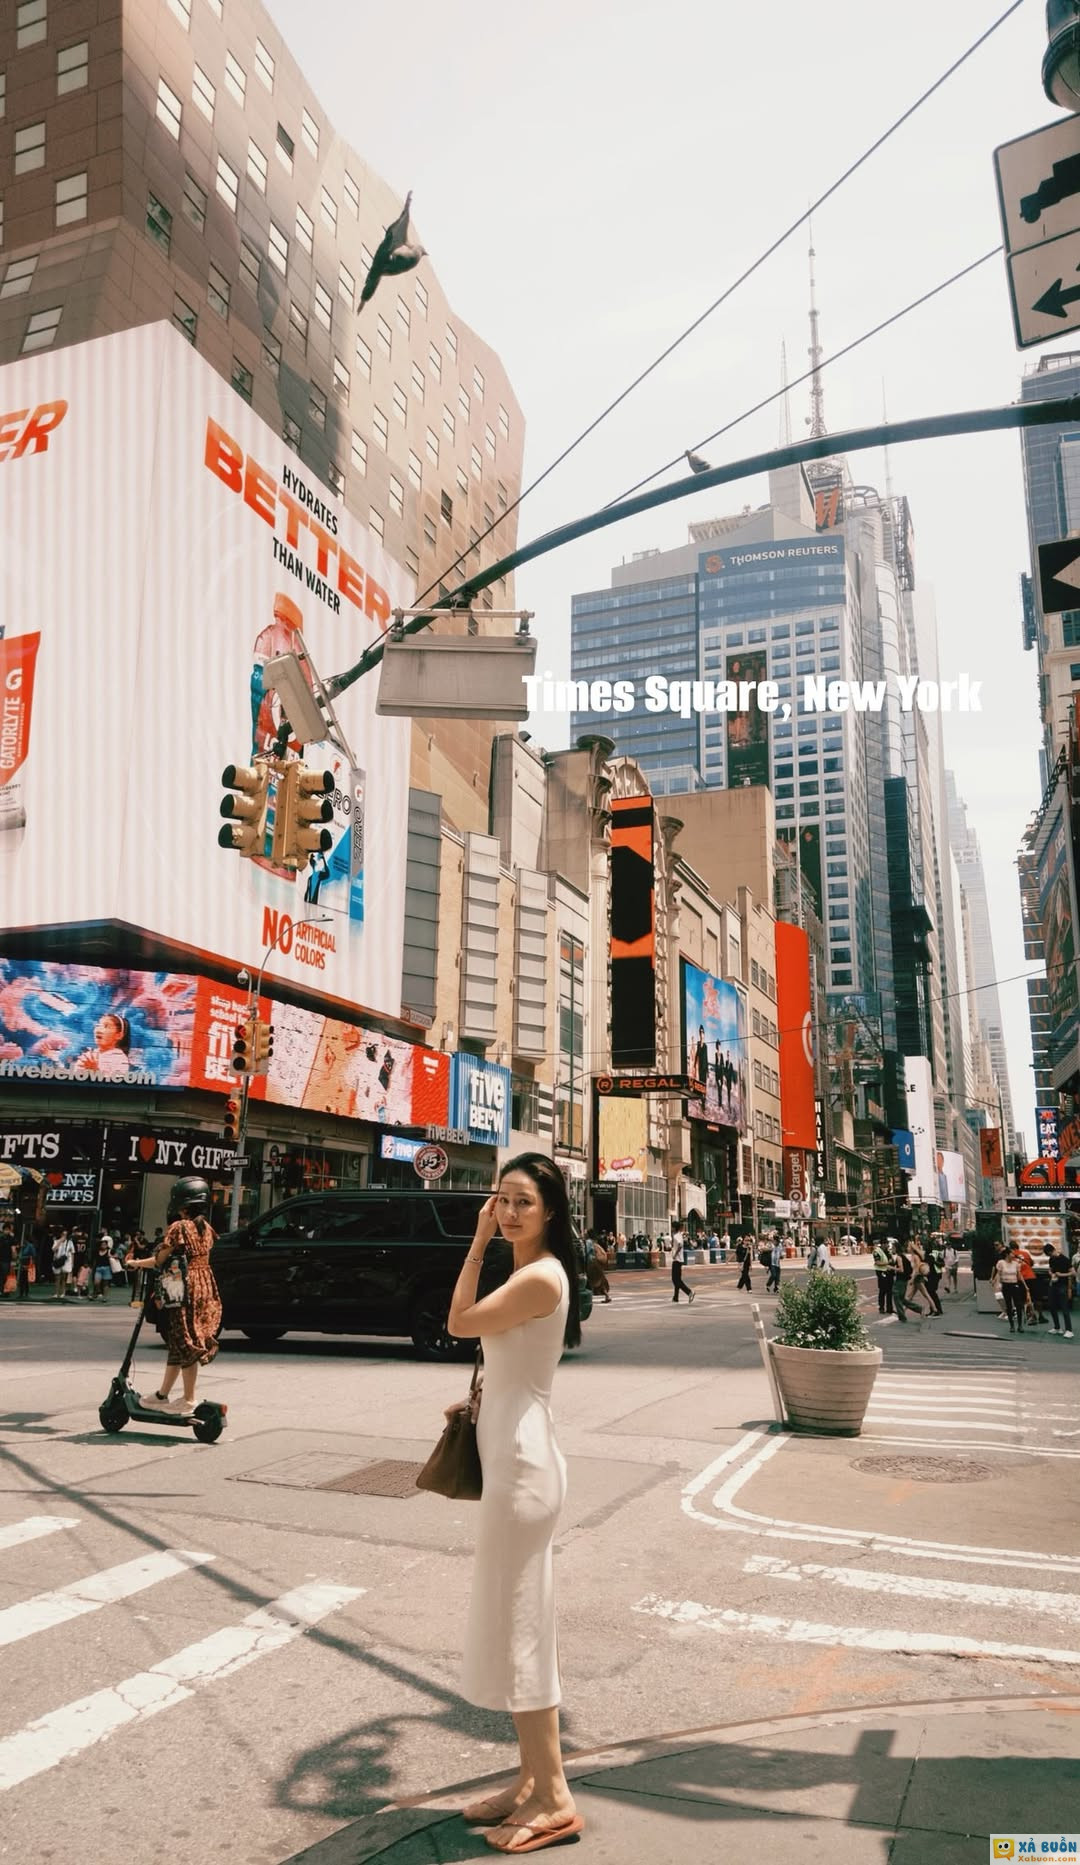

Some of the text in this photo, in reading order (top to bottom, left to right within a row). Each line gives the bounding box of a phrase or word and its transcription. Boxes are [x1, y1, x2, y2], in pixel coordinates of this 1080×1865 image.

[283, 465, 338, 535] HYDRATES
[204, 416, 392, 631] BETTER
[730, 545, 838, 566] THOMSON REUTERS
[272, 536, 341, 615] THAN WATER
[0, 697, 20, 769] GATORLYTE
[353, 806, 366, 865] ZERO
[263, 906, 293, 955] NO
[296, 923, 336, 954] ARTIFICIAL
[295, 944, 326, 970] COLORS
[0, 1058, 157, 1086] fivebelow.com
[470, 1069, 505, 1109] five
[619, 1078, 681, 1089] REGAL
[0, 1133, 60, 1159] FTS
[129, 1136, 139, 1162] I
[155, 1140, 187, 1167] NY
[191, 1145, 238, 1172] GIFT
[64, 1173, 96, 1188] NY
[789, 1152, 803, 1189] target
